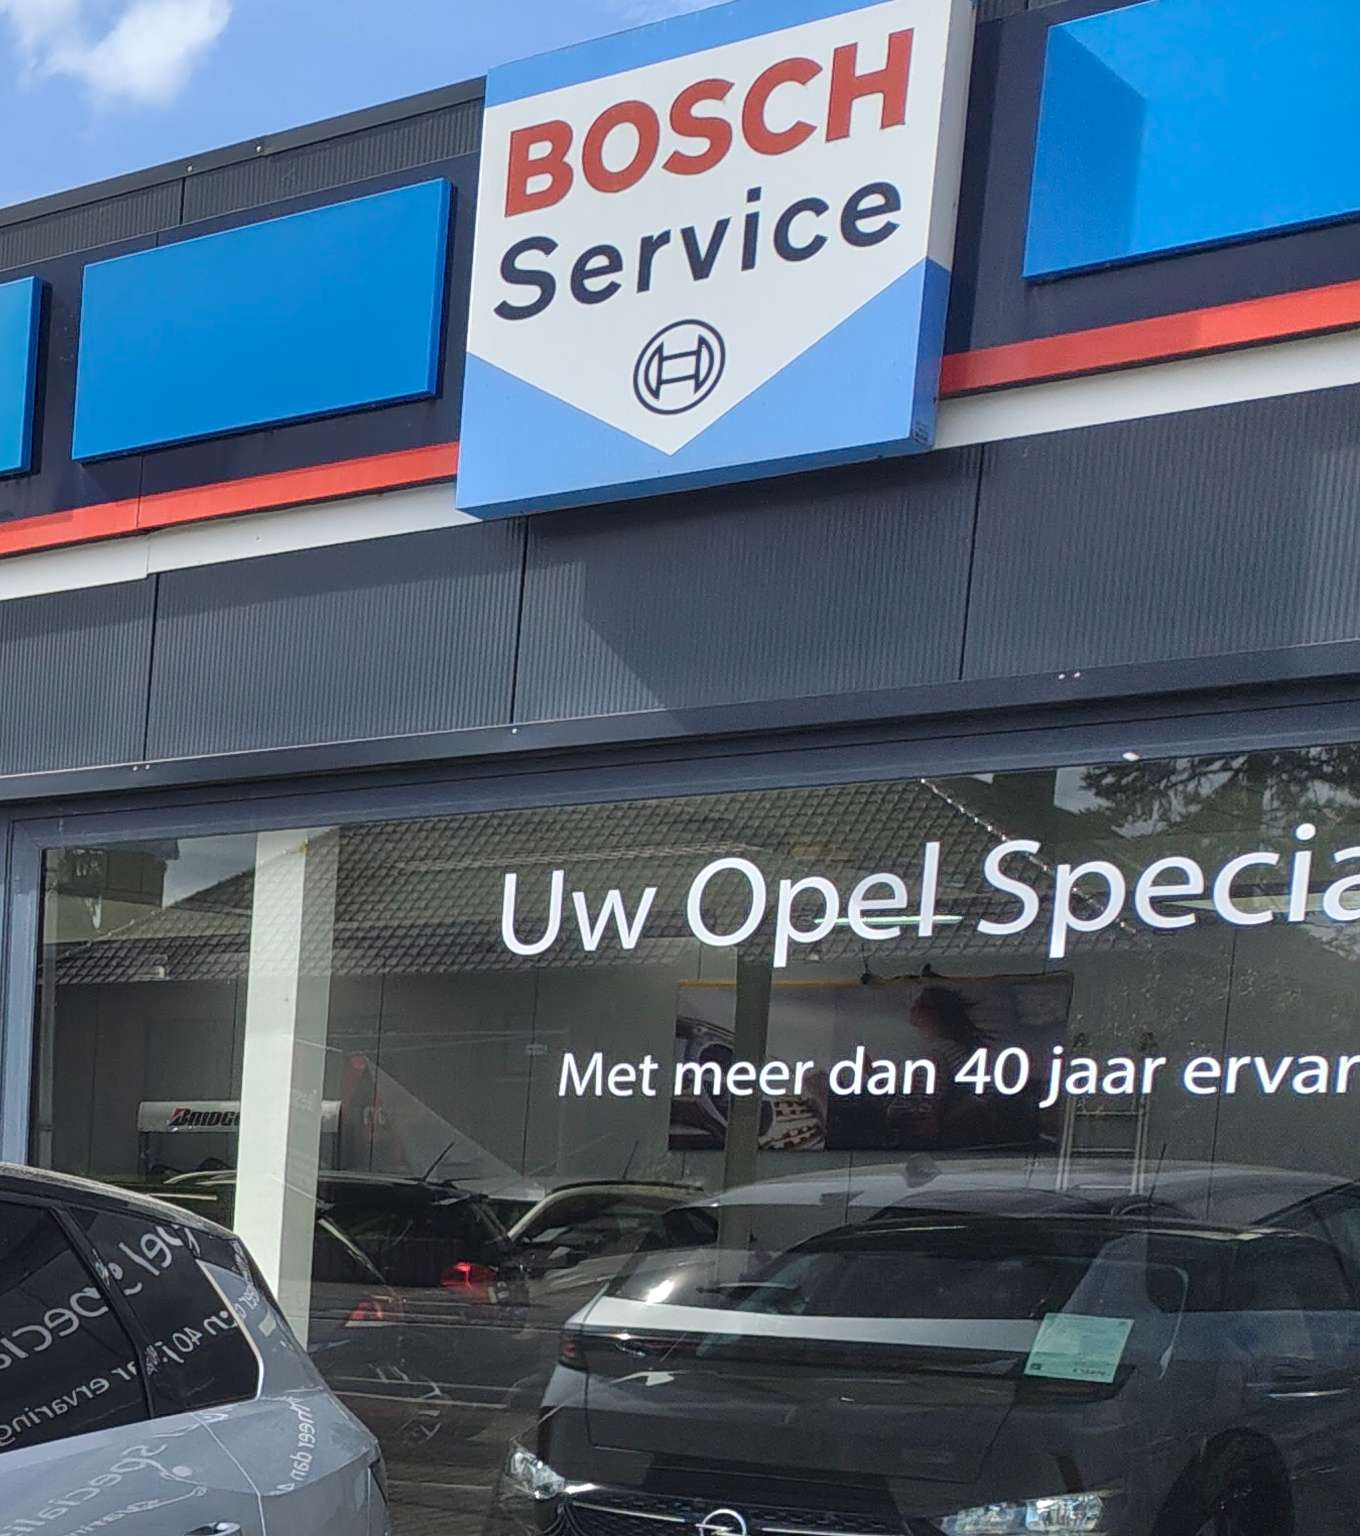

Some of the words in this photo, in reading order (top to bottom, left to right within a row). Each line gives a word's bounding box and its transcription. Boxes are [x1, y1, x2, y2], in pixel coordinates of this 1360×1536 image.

[505, 28, 914, 217] BOSCH
[493, 181, 902, 320] Service
[501, 869, 658, 956] Uw
[687, 841, 940, 968] Opel
[558, 1052, 658, 1097] Met
[674, 1059, 814, 1097] meer
[829, 1046, 936, 1097] dan
[954, 1047, 1030, 1096] 40
[1039, 1045, 1168, 1108] jaar
